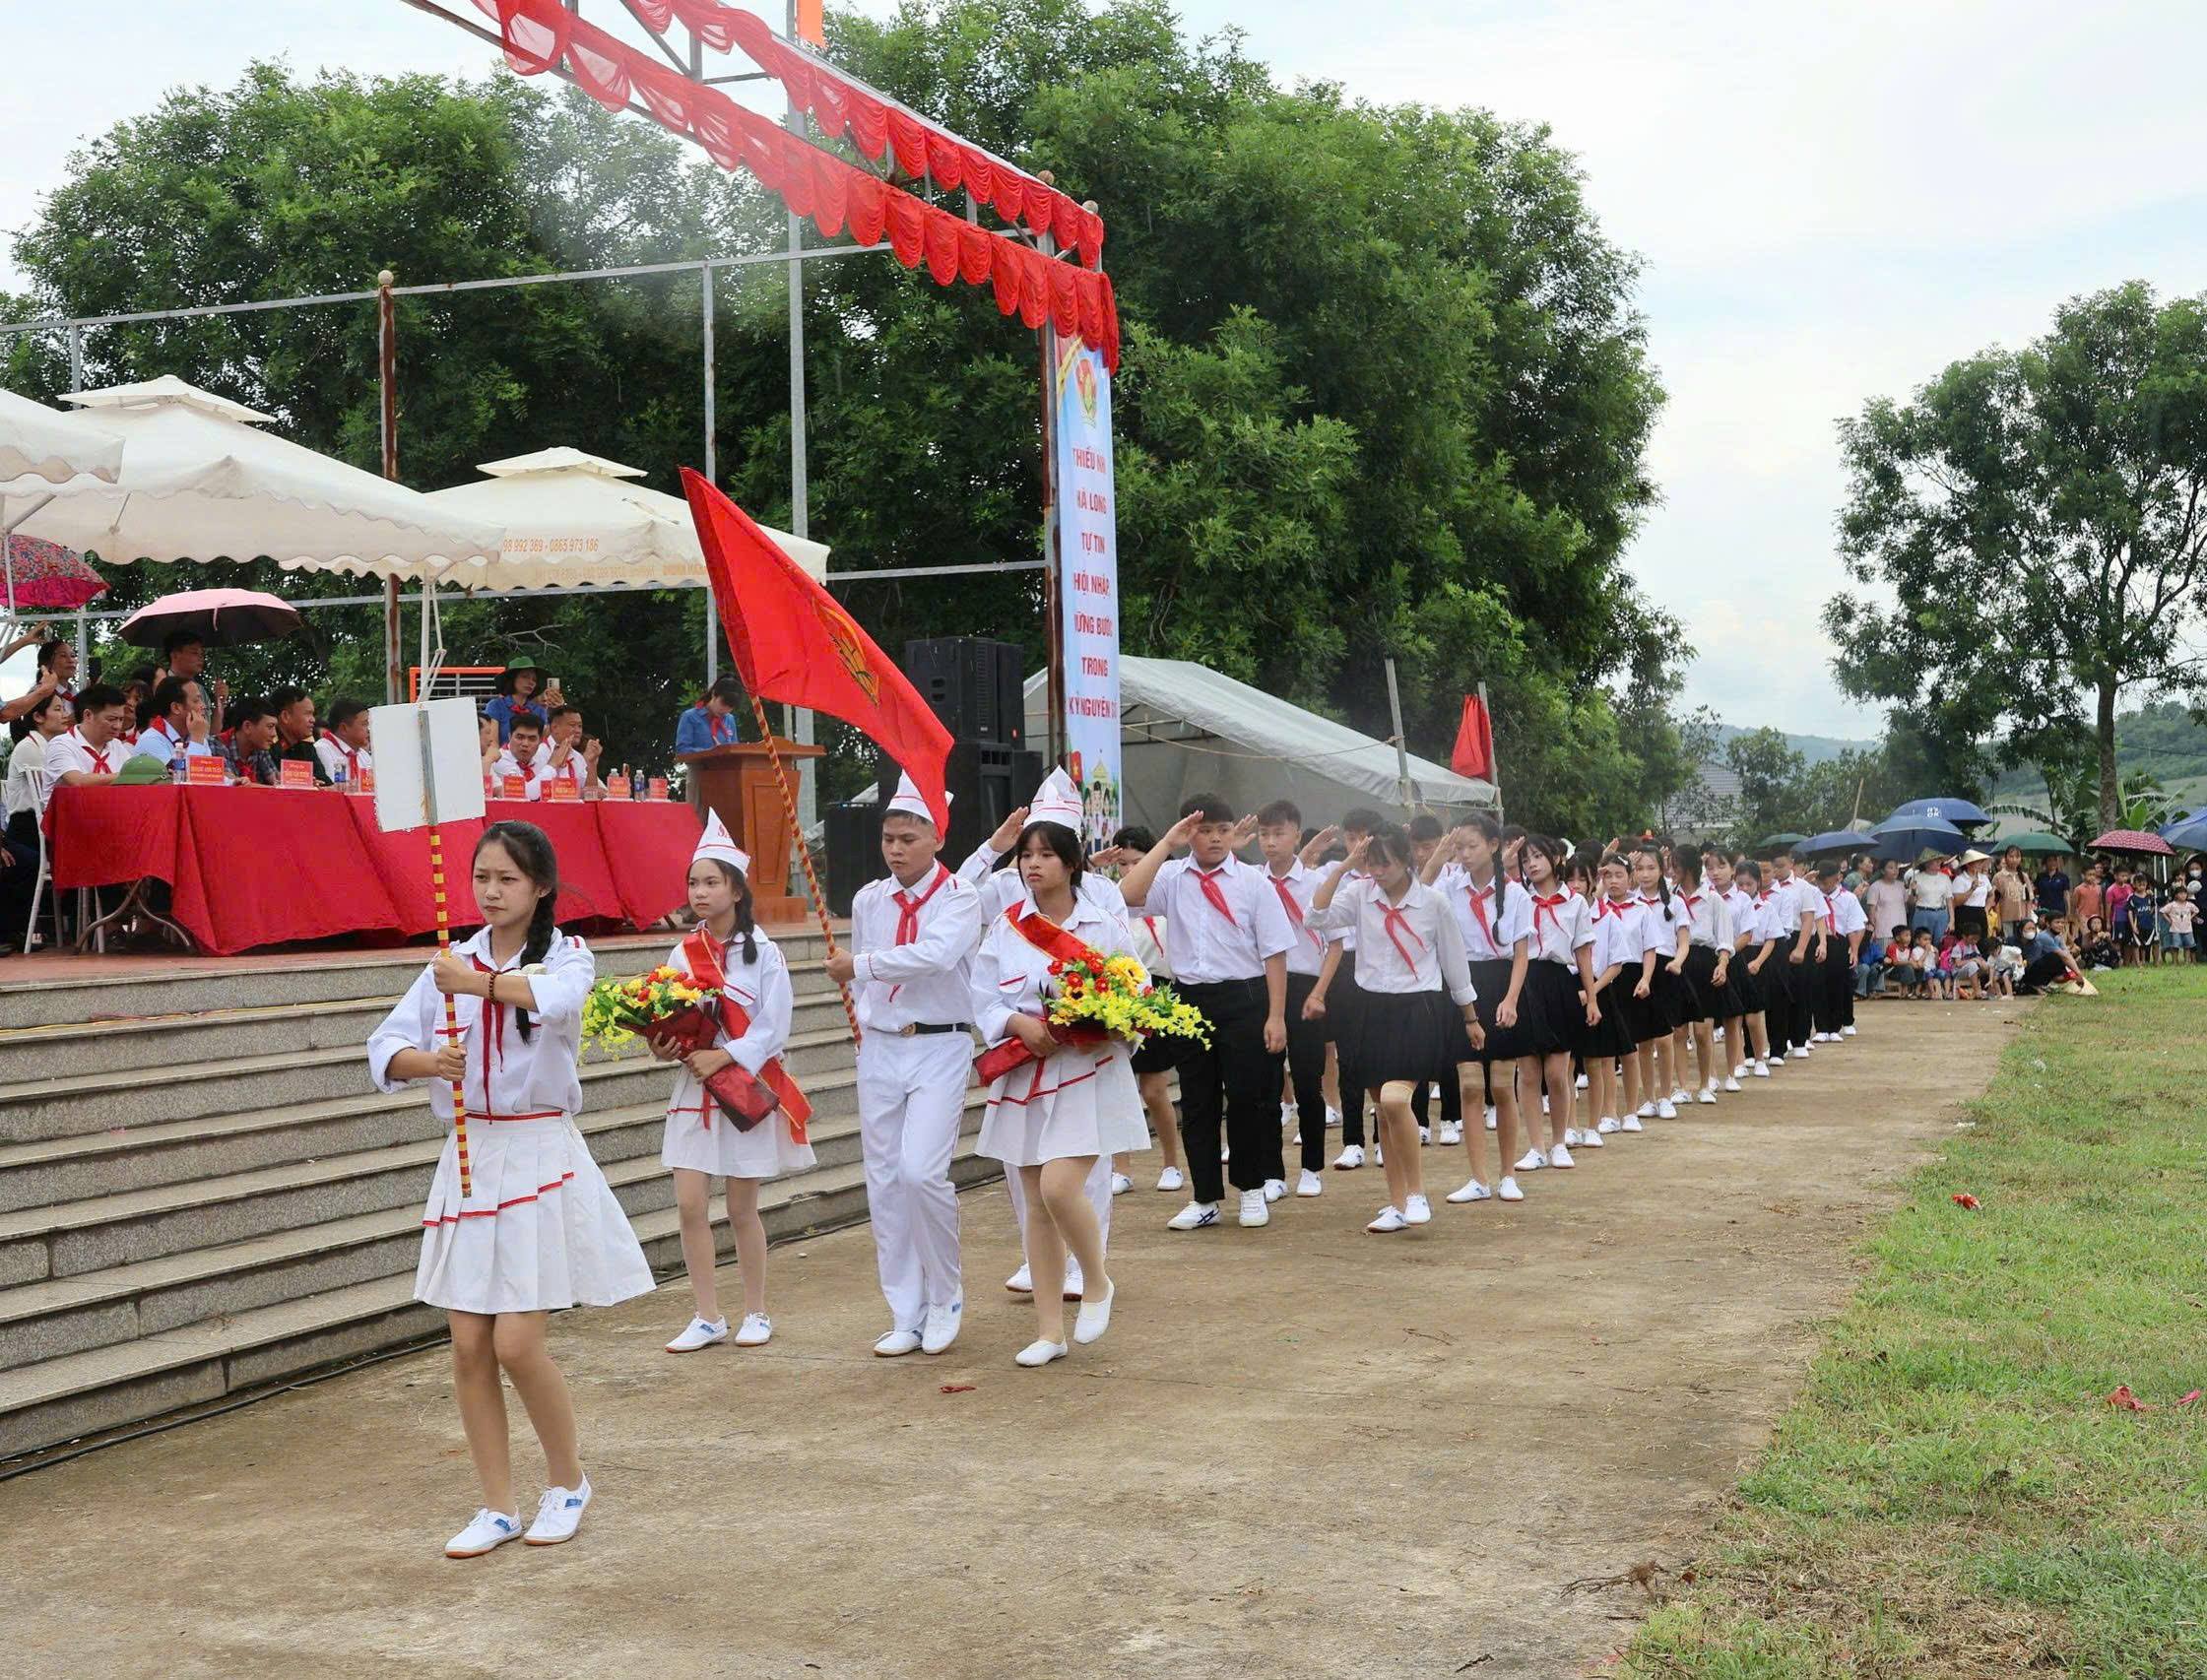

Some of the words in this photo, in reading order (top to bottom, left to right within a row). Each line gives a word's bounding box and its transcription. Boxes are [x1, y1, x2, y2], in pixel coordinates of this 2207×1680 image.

[1093, 534, 1106, 553] TIN
[1073, 569, 1089, 596] HỘI
[1081, 657, 1109, 678] TRONG
[1080, 695, 1111, 719] NGUYÊN
